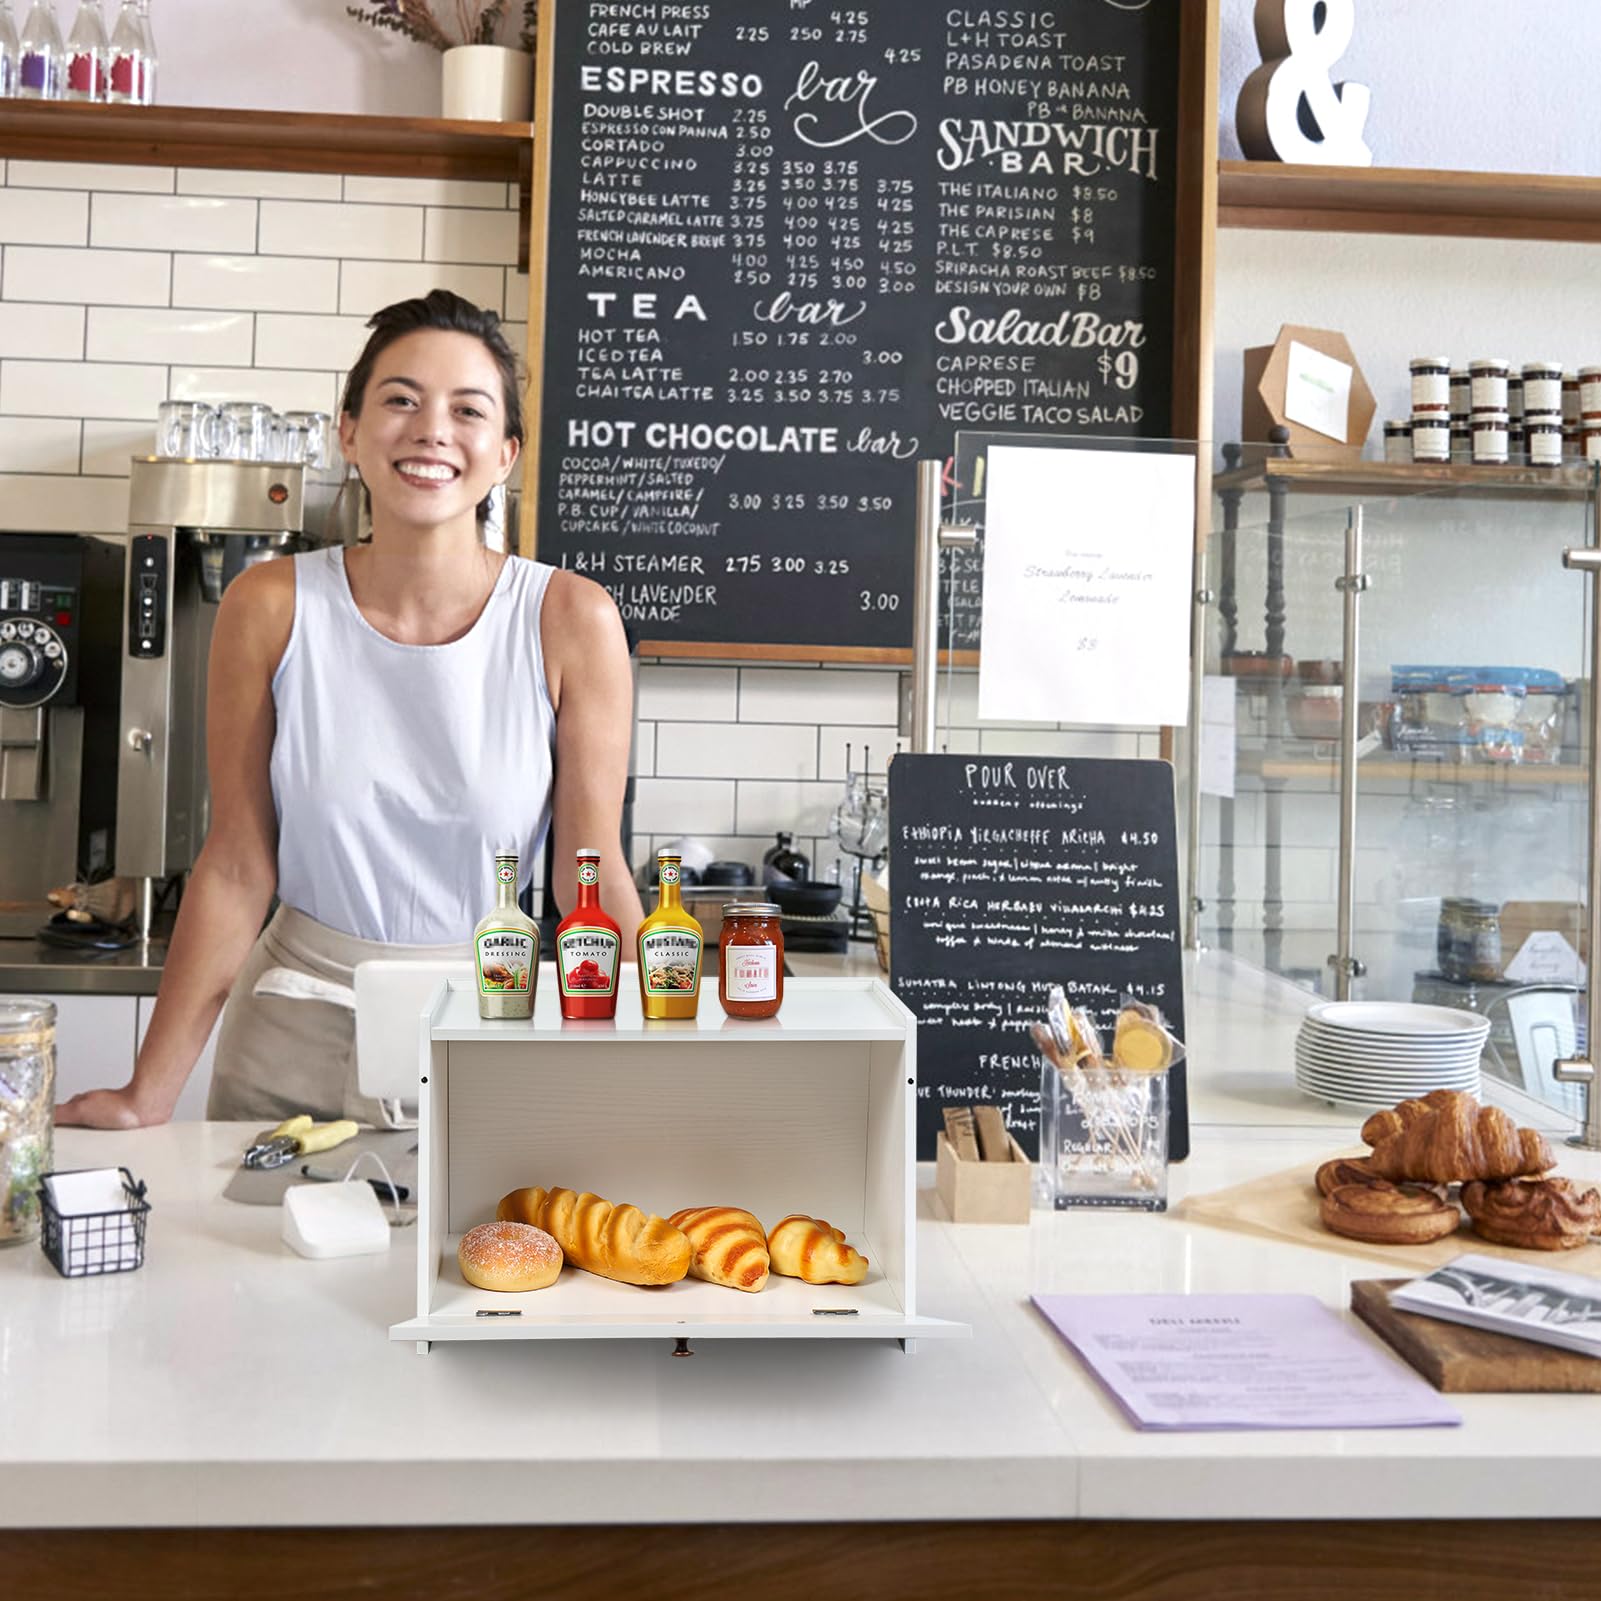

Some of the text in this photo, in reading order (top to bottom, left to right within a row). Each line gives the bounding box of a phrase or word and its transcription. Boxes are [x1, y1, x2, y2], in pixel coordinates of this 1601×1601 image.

[589, 3, 869, 26] FRENCH PRESS 4.25
[946, 9, 1056, 29] CLASSIC
[588, 23, 631, 37] CAFE
[635, 24, 659, 37] AU
[663, 24, 703, 39] LAIT
[946, 32, 1067, 49] L+H TOAST
[587, 41, 633, 54] COLD
[640, 42, 692, 55] BREW
[946, 52, 1126, 72] PASADENA TOAST
[944, 76, 1130, 100] PB HONEY BANANA
[580, 61, 917, 147] ESPRESSO bar
[583, 103, 767, 123] DOUBLE SHOT 2.25
[1028, 102, 1051, 119] PB
[1072, 103, 1148, 124] BANANA
[581, 122, 649, 136] ESPRESSO
[651, 124, 676, 136] CON
[678, 124, 728, 139] PANNA
[581, 138, 774, 158] CORTADO 3.00
[937, 117, 1159, 180] SANDWICH
[581, 156, 697, 171] CAPPUCCINO
[823, 160, 858, 175] 3.75
[1001, 151, 1101, 176] BAR
[582, 172, 643, 187] LATTE
[876, 179, 914, 194] 3.75
[938, 182, 972, 197] THE
[976, 184, 1058, 201] ITALIANO
[580, 188, 657, 206] HONEYBEE
[662, 194, 710, 207] LATTE
[577, 208, 625, 222] SALTED
[626, 211, 684, 226] CARAMEL
[686, 215, 725, 228] LATTE
[938, 203, 1093, 224] THE PARISIAN $8
[577, 229, 624, 242] FRENCH
[626, 231, 688, 248] LAVENDER
[938, 223, 1095, 244] THE CAPRESE $9
[580, 247, 641, 261] MOCHA
[992, 242, 1042, 259] $8.50
[578, 263, 686, 281] AMERICANO
[935, 260, 1011, 277] SRIRACHA
[1016, 265, 1068, 280] ROAST
[1072, 265, 1112, 280] BEEF
[935, 280, 1102, 302] DESIGN YOUR OWN $8
[587, 290, 867, 326] TEA bar
[578, 328, 616, 343] HOT
[623, 328, 660, 343] TEA
[819, 332, 857, 346] 2.00
[935, 306, 1147, 348] Salad Bar
[578, 348, 903, 365] ICED TEA 3.00
[577, 367, 616, 382] TEA
[621, 367, 683, 382] LATTE
[728, 368, 770, 383] 2.00
[936, 349, 1139, 390] CAPRESE $9
[575, 386, 619, 400] CHAI
[621, 386, 655, 400] TEA
[658, 387, 714, 401] LATTE
[936, 377, 1090, 399] CHOPPED ITALIAN
[938, 402, 1144, 424] VEGGIE TACO SALAD
[567, 419, 919, 459] HOT CHOCOLATE bar
[728, 492, 763, 511] 3.00
[613, 554, 705, 575] STEAMER
[814, 560, 850, 575] 3.25
[631, 584, 718, 605] LAVENDER
[621, 590, 900, 621] ONADE 3.00
[965, 762, 1070, 789] POUR OVER
[979, 1054, 1040, 1069] FRENCH
